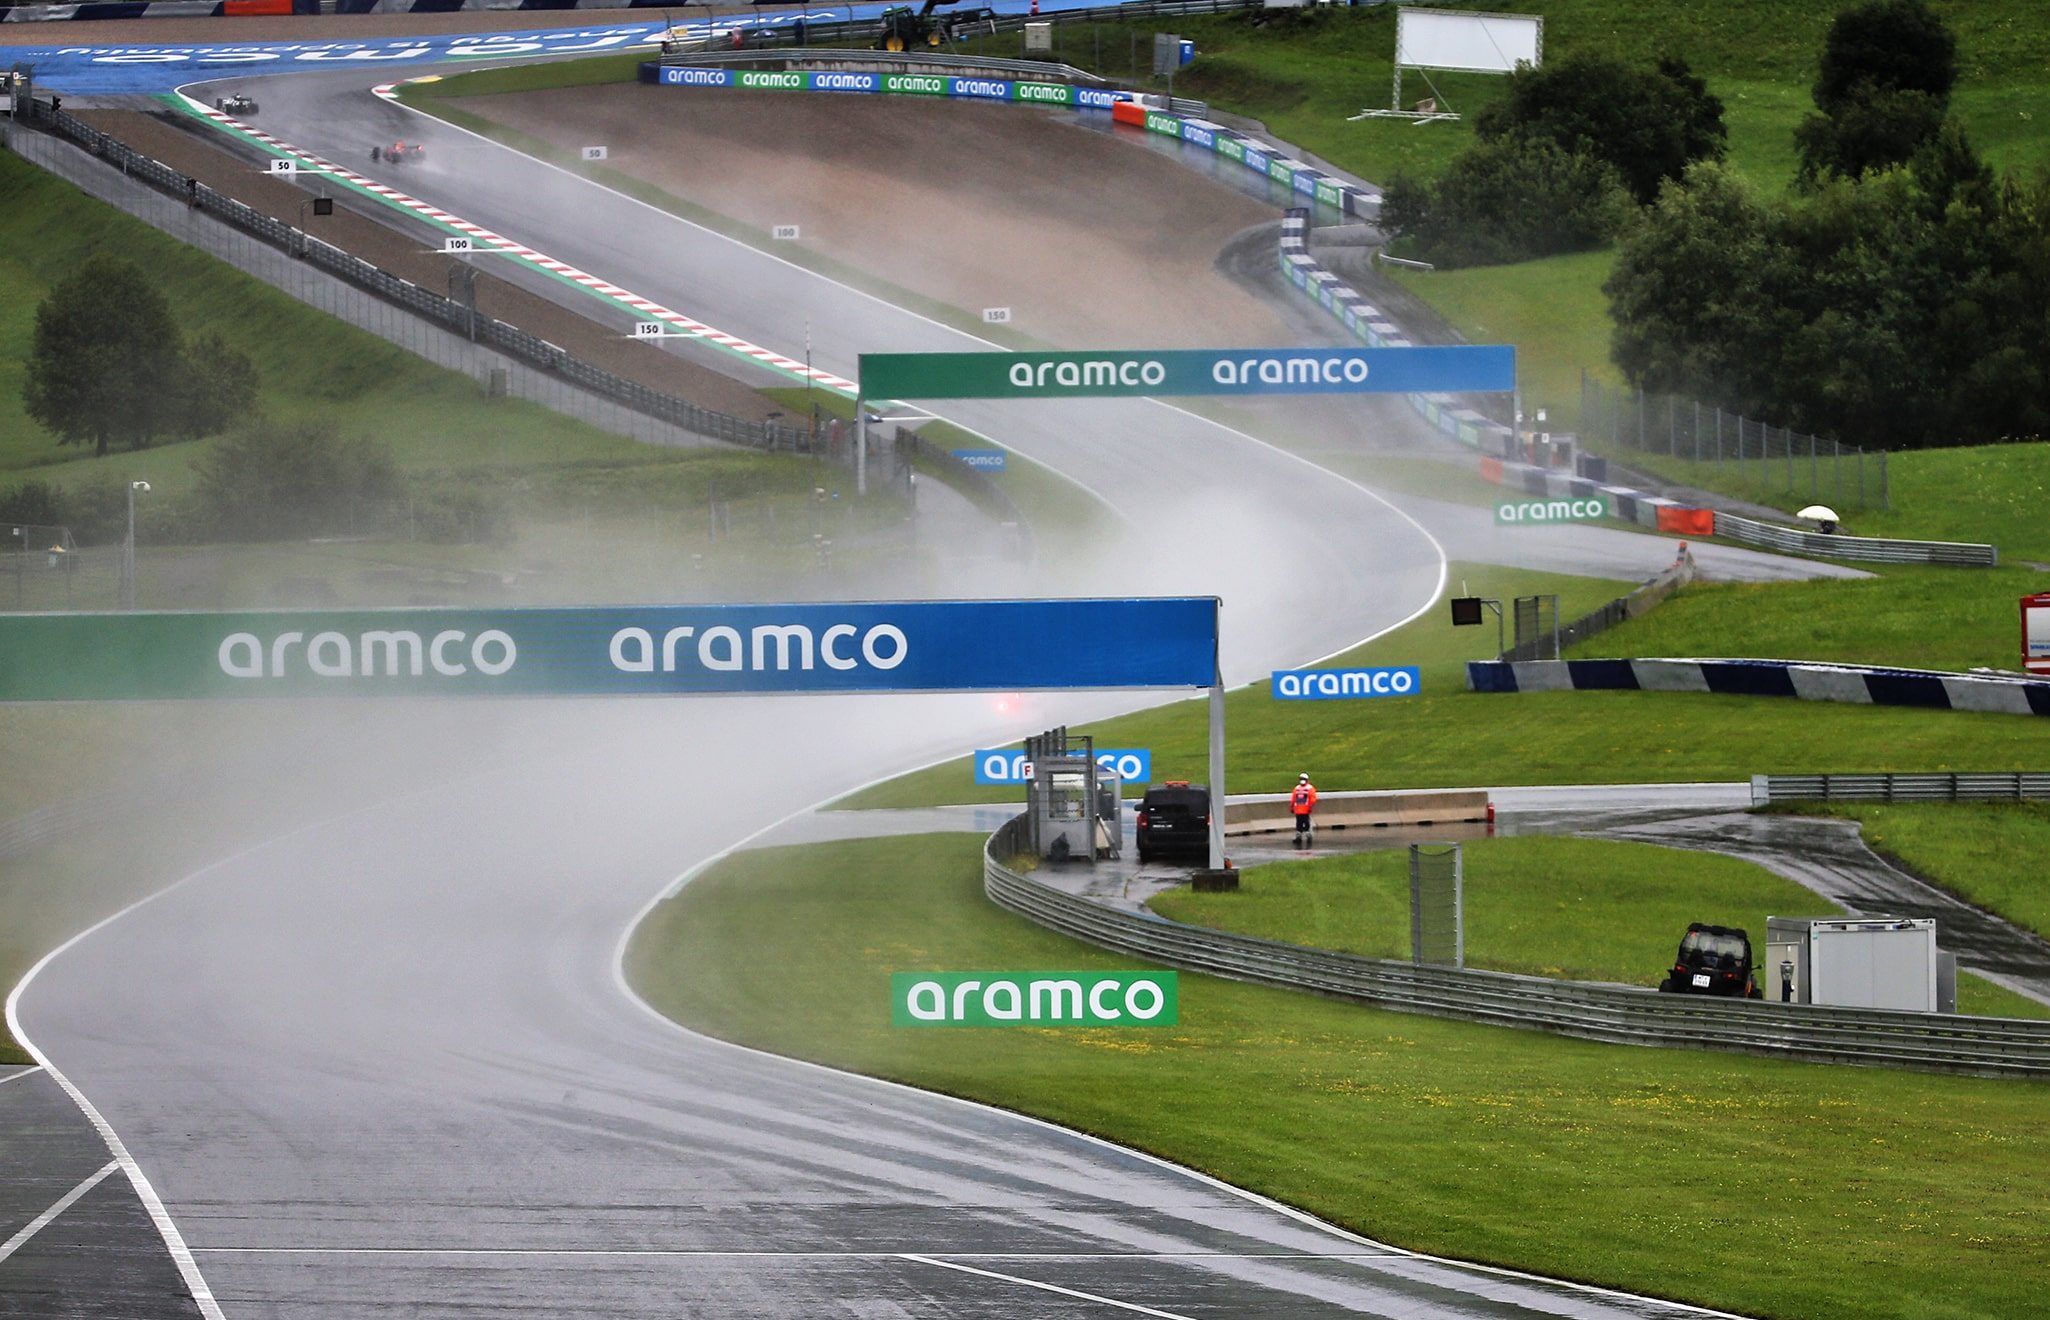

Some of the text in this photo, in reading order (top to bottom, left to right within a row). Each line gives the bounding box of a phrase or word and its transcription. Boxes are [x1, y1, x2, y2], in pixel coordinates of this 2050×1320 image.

[668, 70, 725, 84] aramco
[743, 72, 800, 87] aramco
[816, 75, 872, 88] aramco
[888, 76, 941, 92] aramco
[955, 79, 1005, 96] aramco
[1020, 84, 1067, 101] aramco
[589, 149, 600, 158] 50
[278, 162, 290, 170] 50
[778, 228, 795, 237] 100
[450, 240, 467, 249] 100
[989, 311, 1006, 320] 150
[641, 324, 659, 334] 150
[1009, 358, 1369, 387] aramco aramco
[962, 456, 1003, 465] ramco
[1500, 500, 1602, 521] aramco
[218, 623, 908, 678] aramco aramco
[1279, 671, 1412, 696] aramco
[1024, 765, 1031, 776] F
[907, 980, 1164, 1020] aramco
